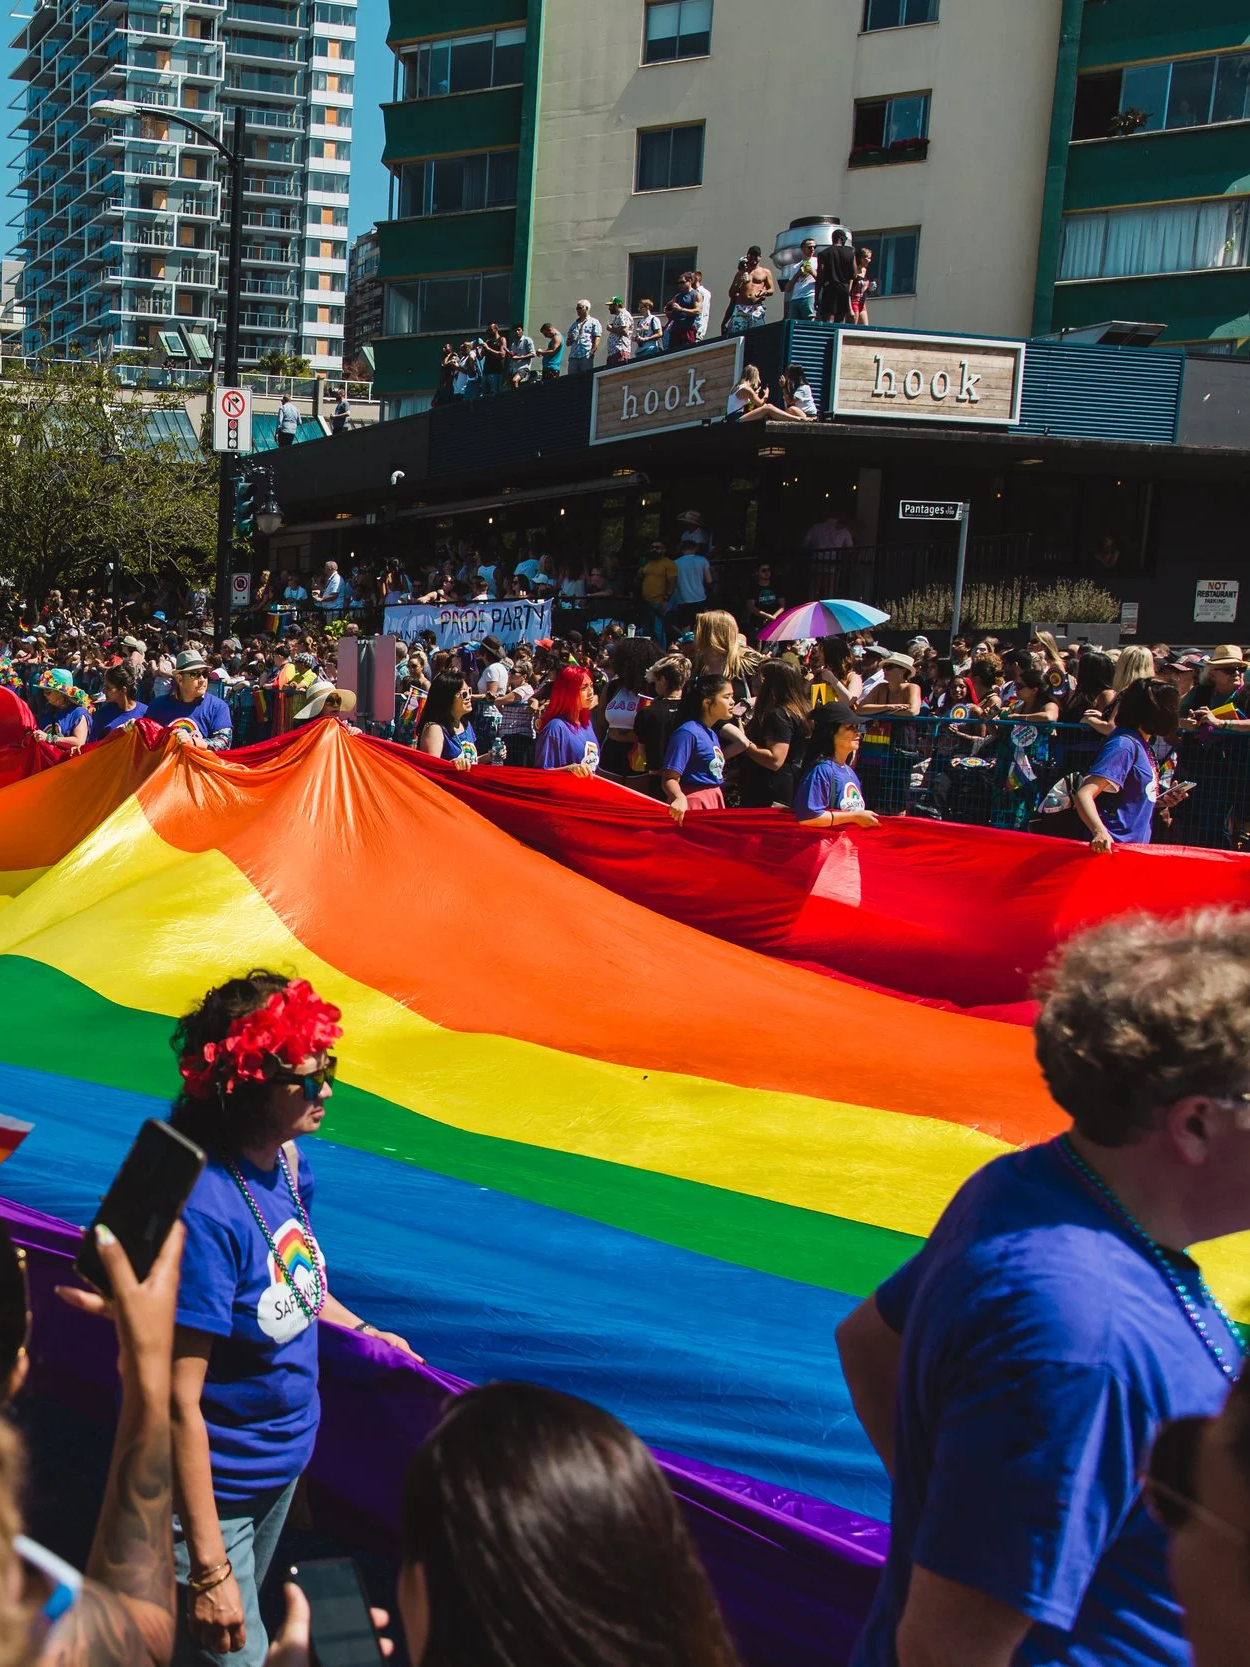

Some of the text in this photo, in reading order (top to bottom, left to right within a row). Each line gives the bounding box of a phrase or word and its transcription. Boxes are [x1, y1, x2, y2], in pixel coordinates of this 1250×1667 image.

[620, 367, 706, 421] hook
[871, 354, 983, 404] hook
[904, 504, 945, 516] Pantages
[1207, 582, 1227, 590] NOT
[440, 605, 546, 635] PRIDE PARTY
